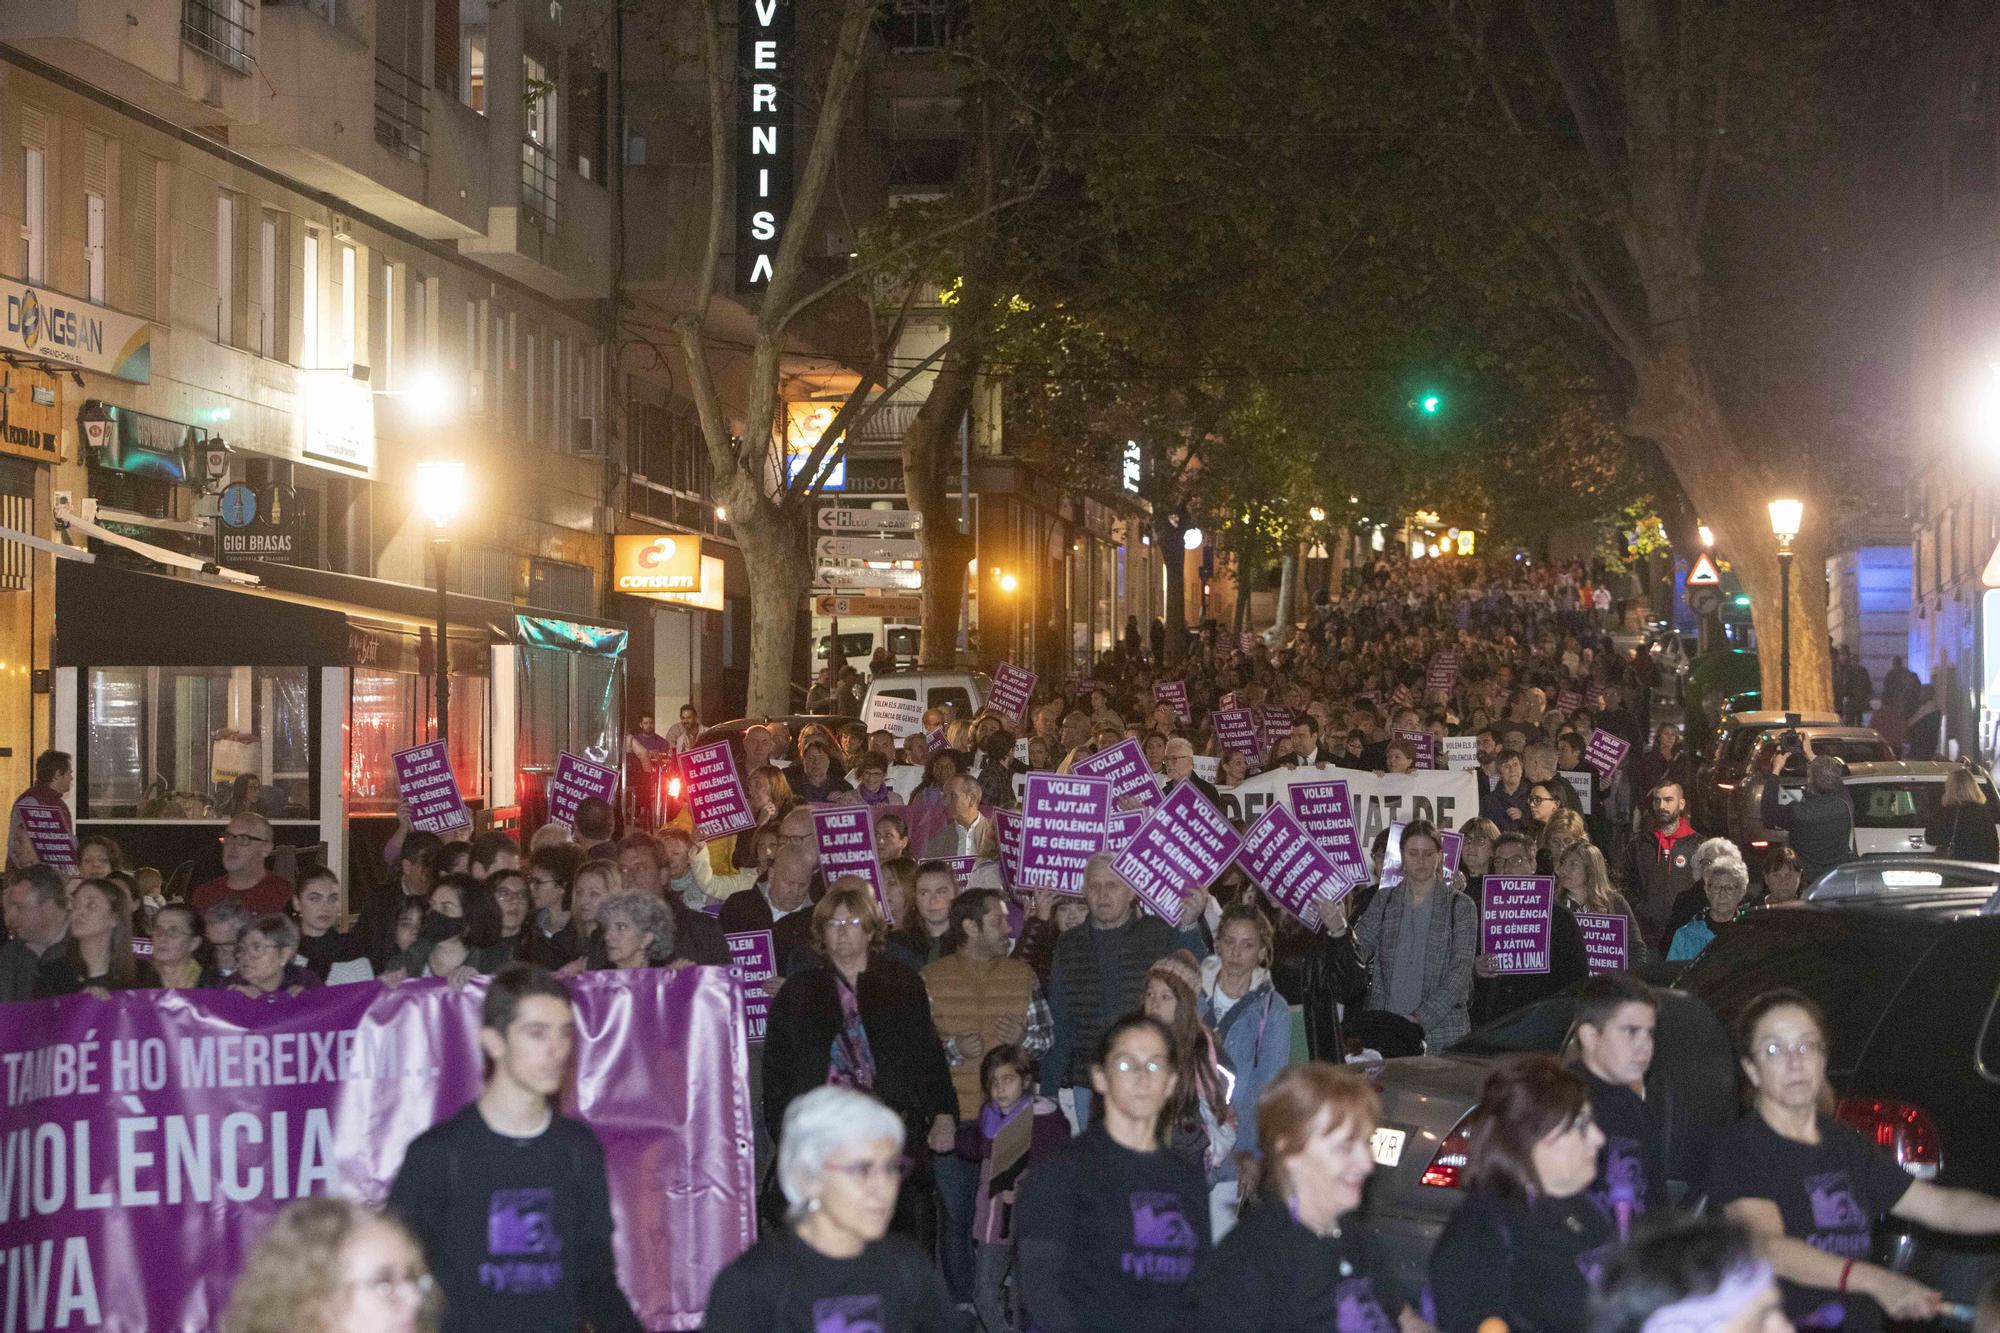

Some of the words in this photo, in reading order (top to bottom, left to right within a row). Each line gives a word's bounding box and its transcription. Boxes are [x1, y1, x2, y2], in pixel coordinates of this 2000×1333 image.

[750, 0, 776, 282] VERNISA
[8, 288, 102, 354] DONGSAN
[224, 535, 246, 550] GIGI
[250, 535, 292, 550] BRASAS
[620, 575, 693, 588] consum
[898, 703, 916, 712] JUTJATS
[405, 748, 434, 763] VOLEM
[691, 750, 717, 764] VOLEM
[1089, 750, 1124, 773] VOLEM
[403, 768, 413, 778] EL
[414, 760, 441, 775] JUTJAT
[572, 761, 603, 780] VOLEM
[688, 770, 698, 778] EL
[700, 762, 724, 776] JUTJAT
[400, 783, 411, 792] DE
[412, 772, 453, 789] VIOLÈNCIA
[555, 781, 564, 791] DE
[563, 772, 572, 782] EL
[574, 777, 604, 793] JUTJAT
[687, 785, 696, 794] DE
[696, 774, 736, 791] VIOLÈNCIA
[1048, 781, 1091, 796] VOLEM
[408, 796, 420, 804] DE
[420, 786, 452, 801] GÈNERE
[557, 796, 567, 805] DE
[694, 797, 704, 806] DE
[704, 788, 734, 803] GÈNERE
[1303, 787, 1334, 799] VOLEM
[424, 801, 452, 814] XÀTIVA
[558, 809, 564, 817] A
[701, 811, 706, 819] A
[707, 803, 736, 817] XÀTIVA
[1038, 800, 1052, 811] EL
[1054, 802, 1097, 814] JUTJAT
[1300, 805, 1310, 815] EL
[1311, 803, 1342, 814] JUTJAT
[1412, 796, 1455, 829] DE
[439, 815, 446, 828] A
[444, 809, 465, 827] UNA!
[722, 816, 730, 830] A
[728, 811, 749, 828] UNA!
[825, 814, 856, 828] VOLEM
[1026, 817, 1041, 829] DE
[1044, 818, 1104, 833] VIOLÈNCIA
[1192, 798, 1228, 836] VOLEM
[1308, 818, 1354, 831] VIOLÈNCIA
[1174, 804, 1189, 820] EL
[1188, 818, 1224, 852] JUTJAT
[823, 835, 833, 846] EL
[834, 832, 863, 845] JUTJAT
[1032, 836, 1048, 848] DE
[1050, 835, 1096, 851] GÈNERE
[1155, 808, 1173, 827] DE
[1170, 822, 1221, 873] VIOLÈNCIA
[1246, 820, 1275, 854] VOLEM
[1317, 834, 1351, 847] GÈNERE
[820, 854, 831, 864] DE
[830, 849, 875, 864] VIOLÈNCIA
[1148, 829, 1166, 847] DE
[1163, 841, 1204, 880] GÈNERE
[1252, 860, 1264, 873] EL
[1261, 827, 1290, 862] JUTJAT
[1036, 854, 1044, 865] A
[1046, 854, 1088, 868] XÀTIVA
[1261, 876, 1272, 891] DE
[1268, 834, 1308, 880] VIOLÈNCIA
[828, 871, 838, 882] DE
[1119, 852, 1154, 888] TOTES
[1146, 879, 1161, 897] A
[1140, 850, 1151, 860] A
[1149, 854, 1185, 890] XÀTIVA
[1275, 884, 1287, 899] DE
[1282, 851, 1316, 888] GÈNERE
[1060, 872, 1069, 889] A
[1293, 869, 1324, 899] XÀTIVA
[1317, 872, 1346, 901] UNA!
[1500, 881, 1536, 891] VOLEM
[1290, 896, 1299, 907] A
[1493, 896, 1504, 904] EL
[1506, 895, 1541, 904] JUTJAT
[1485, 911, 1496, 919] DE
[1499, 908, 1548, 919] VIOLÈNCIA
[1491, 926, 1502, 935] DE
[1504, 923, 1541, 934] GÈNERE
[1576, 918, 1610, 929] VOLEM
[1495, 941, 1501, 950] A
[1503, 938, 1535, 949] XÀTIVA
[1583, 932, 1616, 941] JUTJAT
[1586, 944, 1624, 956] OLÈNCIA
[1516, 953, 1522, 968] A
[1523, 952, 1544, 967] UNA!
[748, 1019, 756, 1036] A
[4, 1030, 99, 1106] TAMBÉ
[111, 1038, 168, 1092] HO
